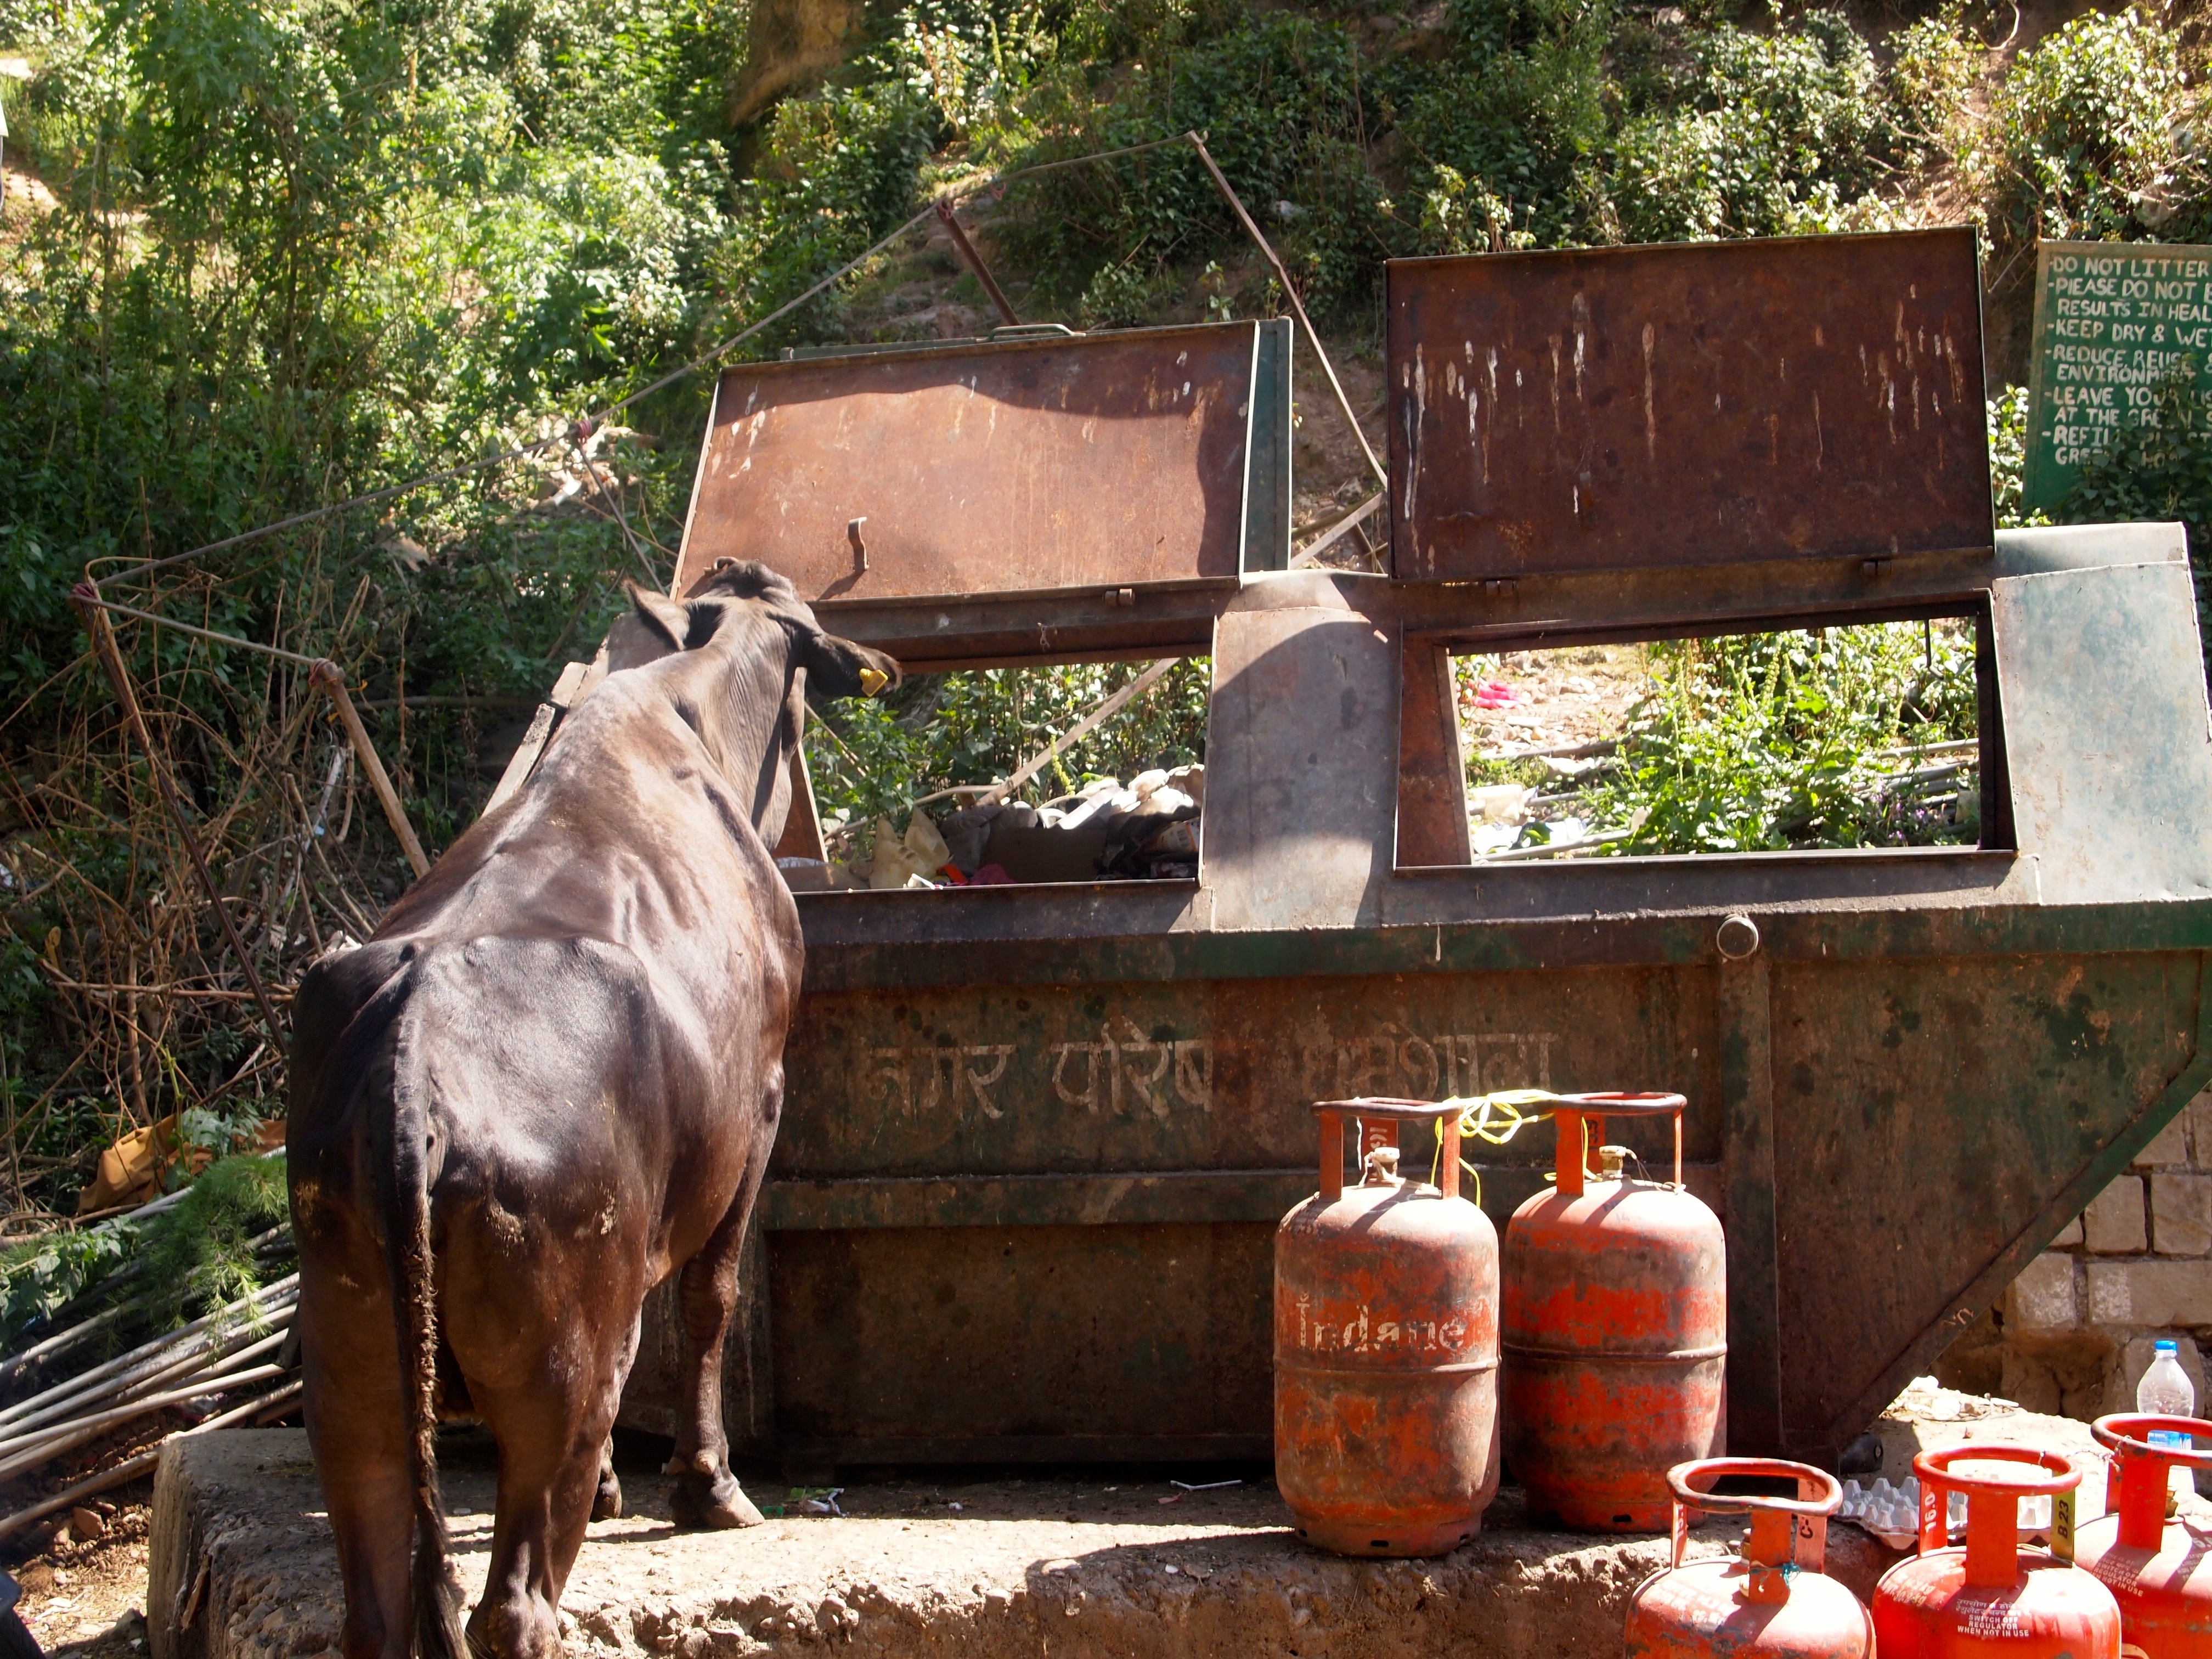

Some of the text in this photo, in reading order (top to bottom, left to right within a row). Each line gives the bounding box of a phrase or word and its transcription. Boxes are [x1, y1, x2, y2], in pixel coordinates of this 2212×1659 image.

[2053, 256, 2209, 278] DO NOT LITTER
[2121, 279, 2149, 299] DO
[2154, 280, 2198, 301] NOT
[2057, 298, 2131, 318] RESULTS
[2137, 302, 2164, 318] IN
[2056, 318, 2104, 339] KEEP
[2112, 323, 2147, 343] DRY
[2151, 324, 2165, 343] &
[2052, 386, 2114, 407] LEAVE
[2053, 406, 2078, 423] AT
[2086, 408, 2120, 426] THE
[871, 1042, 1016, 1119] नगर
[1295, 1293, 1468, 1352] Indane
[1924, 1491, 1937, 1532] 16.0
[2058, 1499, 2069, 1538] B 23
[2094, 1567, 2137, 1587] REGULATOR
[2096, 1562, 2125, 1576] SWITCH
[2102, 1575, 2117, 1585] NOT
[2118, 1580, 2127, 1589] IN
[2128, 1586, 2144, 1598] USE
[1968, 1615, 2000, 1624] SWITCH
[1968, 1621, 2018, 1629] REGULATOR
[1957, 1625, 1980, 1634] WHEN
[1983, 1628, 1999, 1637] NOT
[2013, 1629, 2029, 1638] USE
